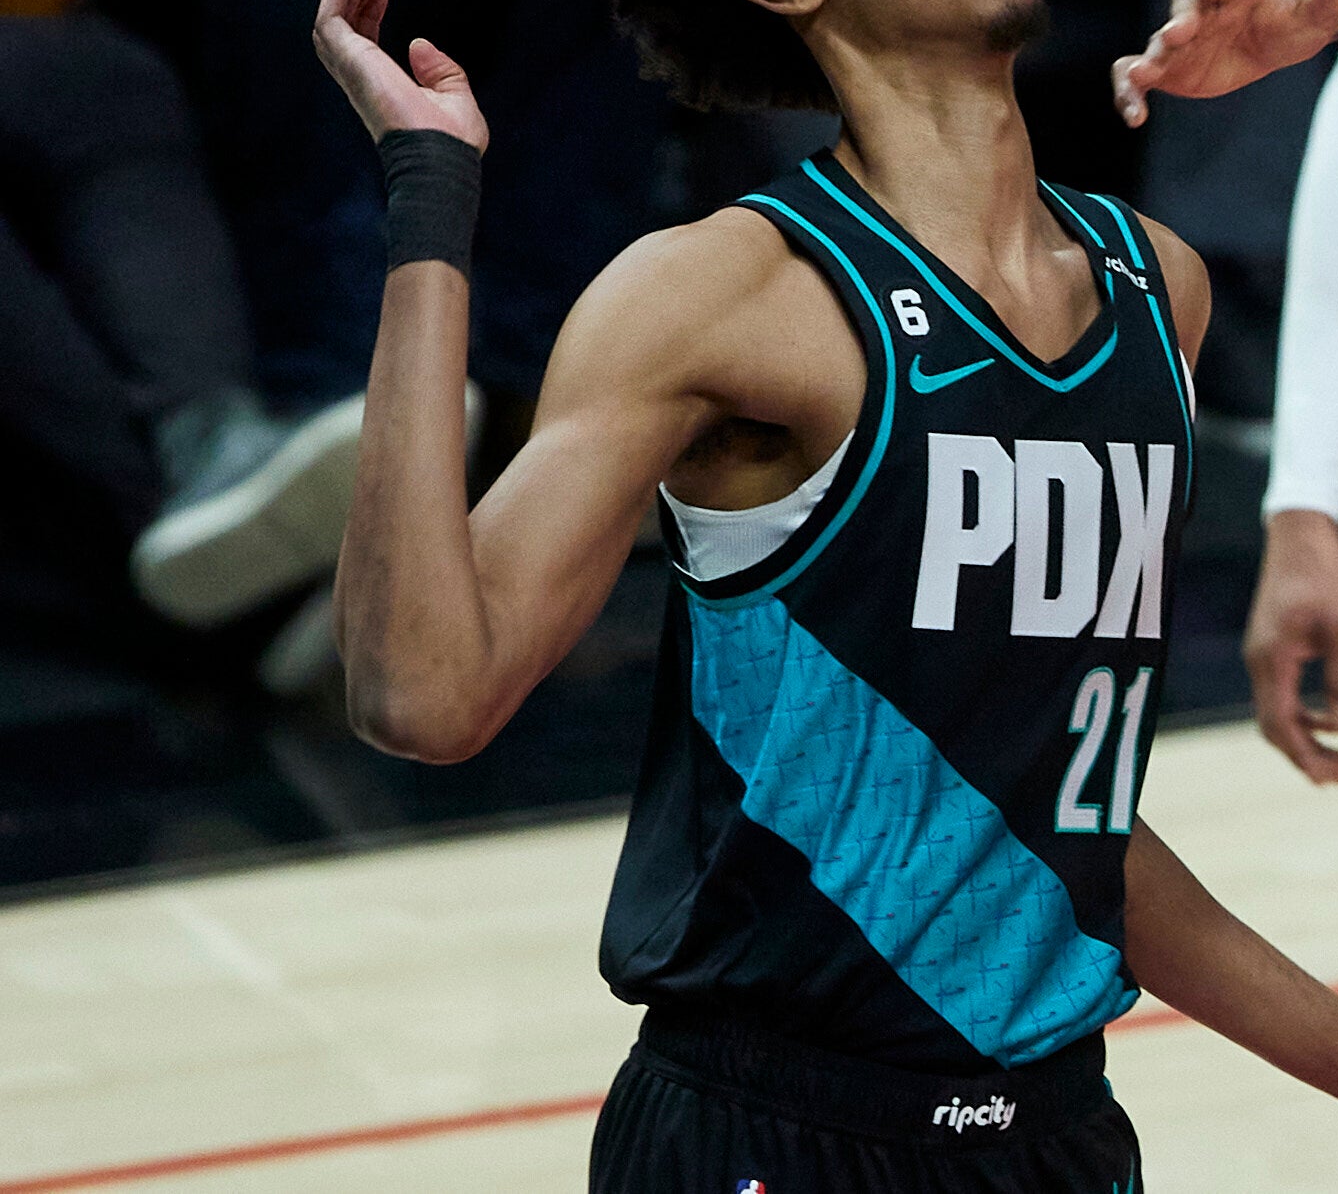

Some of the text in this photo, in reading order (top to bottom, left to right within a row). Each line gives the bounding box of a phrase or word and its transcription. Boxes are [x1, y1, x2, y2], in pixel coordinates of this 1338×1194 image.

[889, 288, 930, 336] 6
[912, 432, 1176, 640] PDX
[1054, 666, 1155, 834] 21
[932, 1095, 1017, 1134] ripcity
